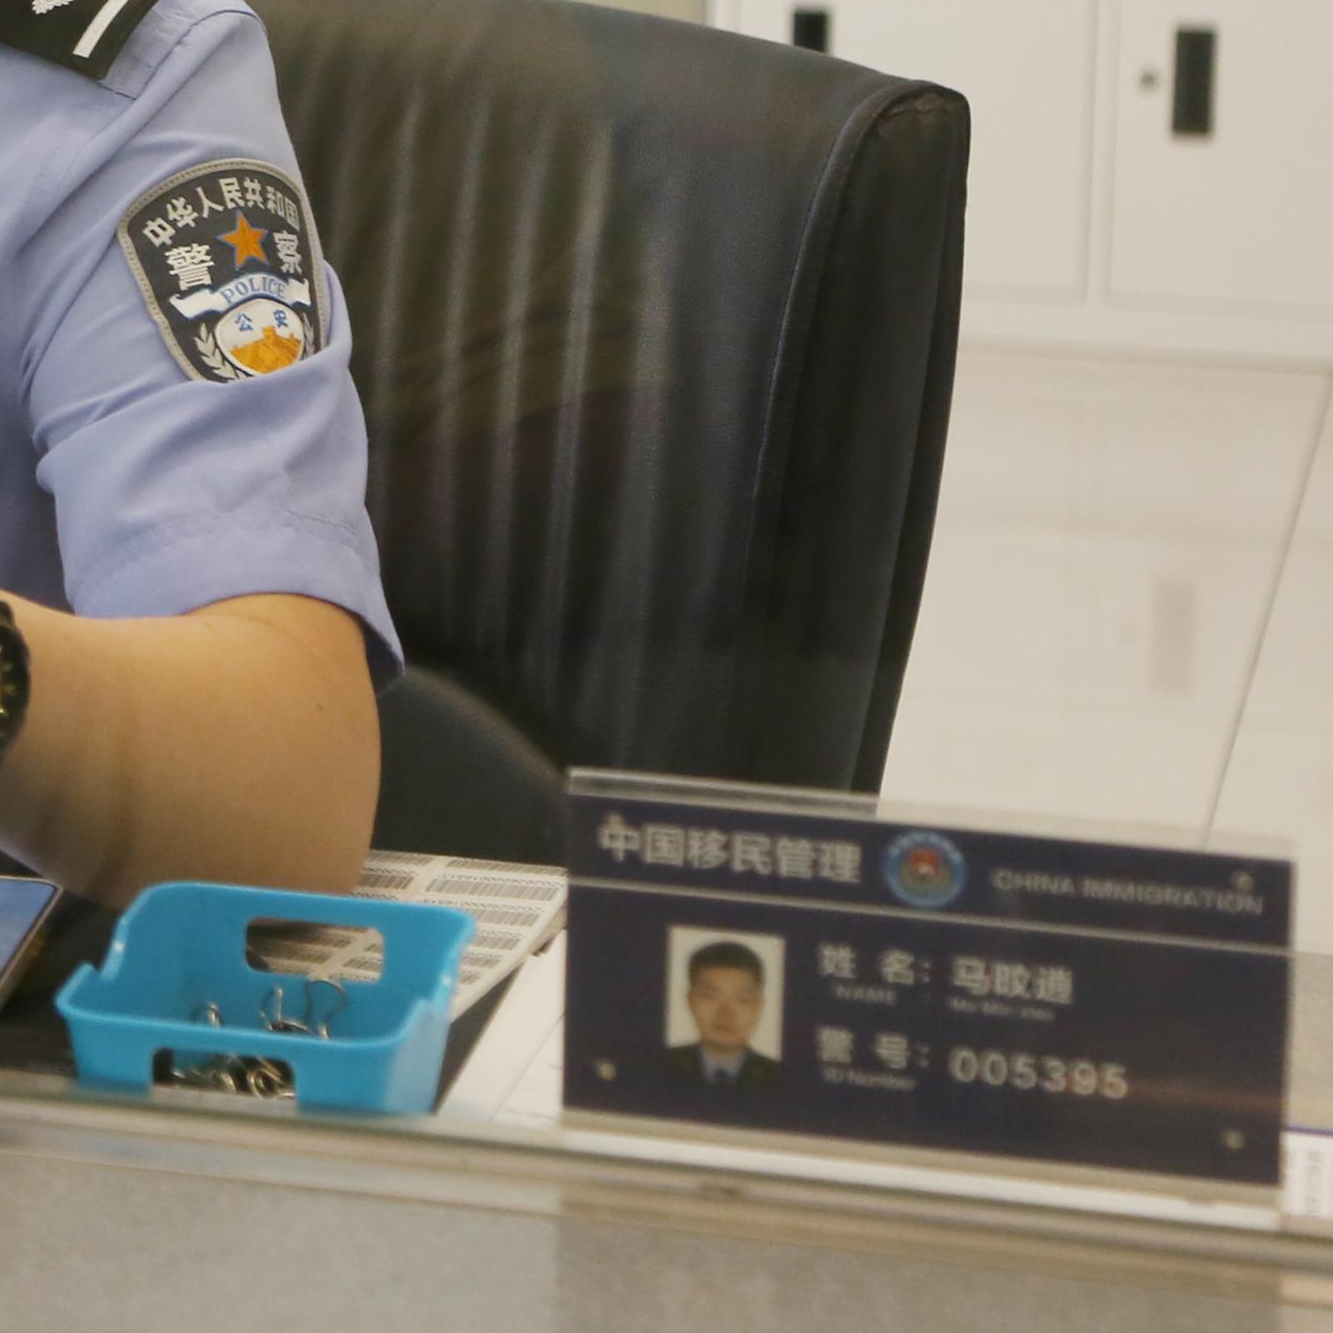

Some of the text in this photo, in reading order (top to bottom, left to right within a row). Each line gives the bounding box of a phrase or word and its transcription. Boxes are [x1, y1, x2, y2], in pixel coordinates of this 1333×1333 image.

[142, 177, 301, 247] 中华人民共和国
[165, 230, 303, 290] 警 察
[220, 276, 288, 303] POLICE
[235, 313, 254, 332] 公
[598, 821, 863, 885] 中国移民管理
[991, 867, 1264, 916] CHINA IMMIGRATION
[949, 1046, 1129, 1099] 005395
